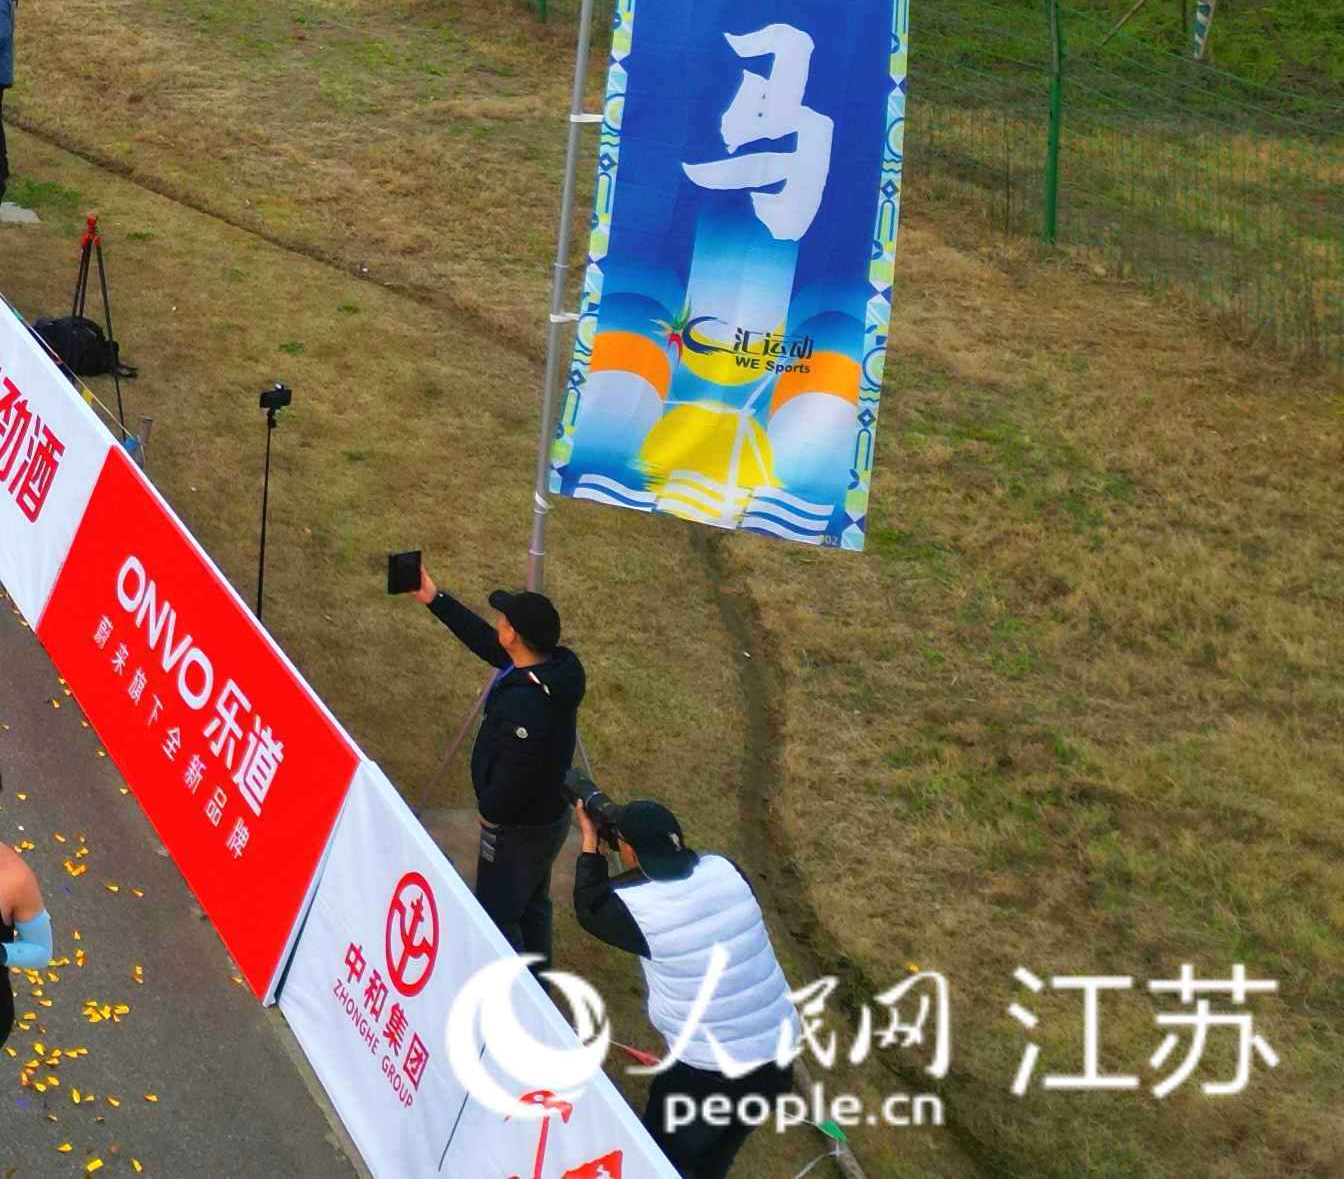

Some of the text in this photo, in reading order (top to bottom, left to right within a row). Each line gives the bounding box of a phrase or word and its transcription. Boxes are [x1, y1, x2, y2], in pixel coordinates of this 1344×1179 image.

[735, 355, 811, 375] WE Sports
[332, 978, 414, 1109] ZHONGHE GROUP
[344, 941, 430, 1092] 中和集团
